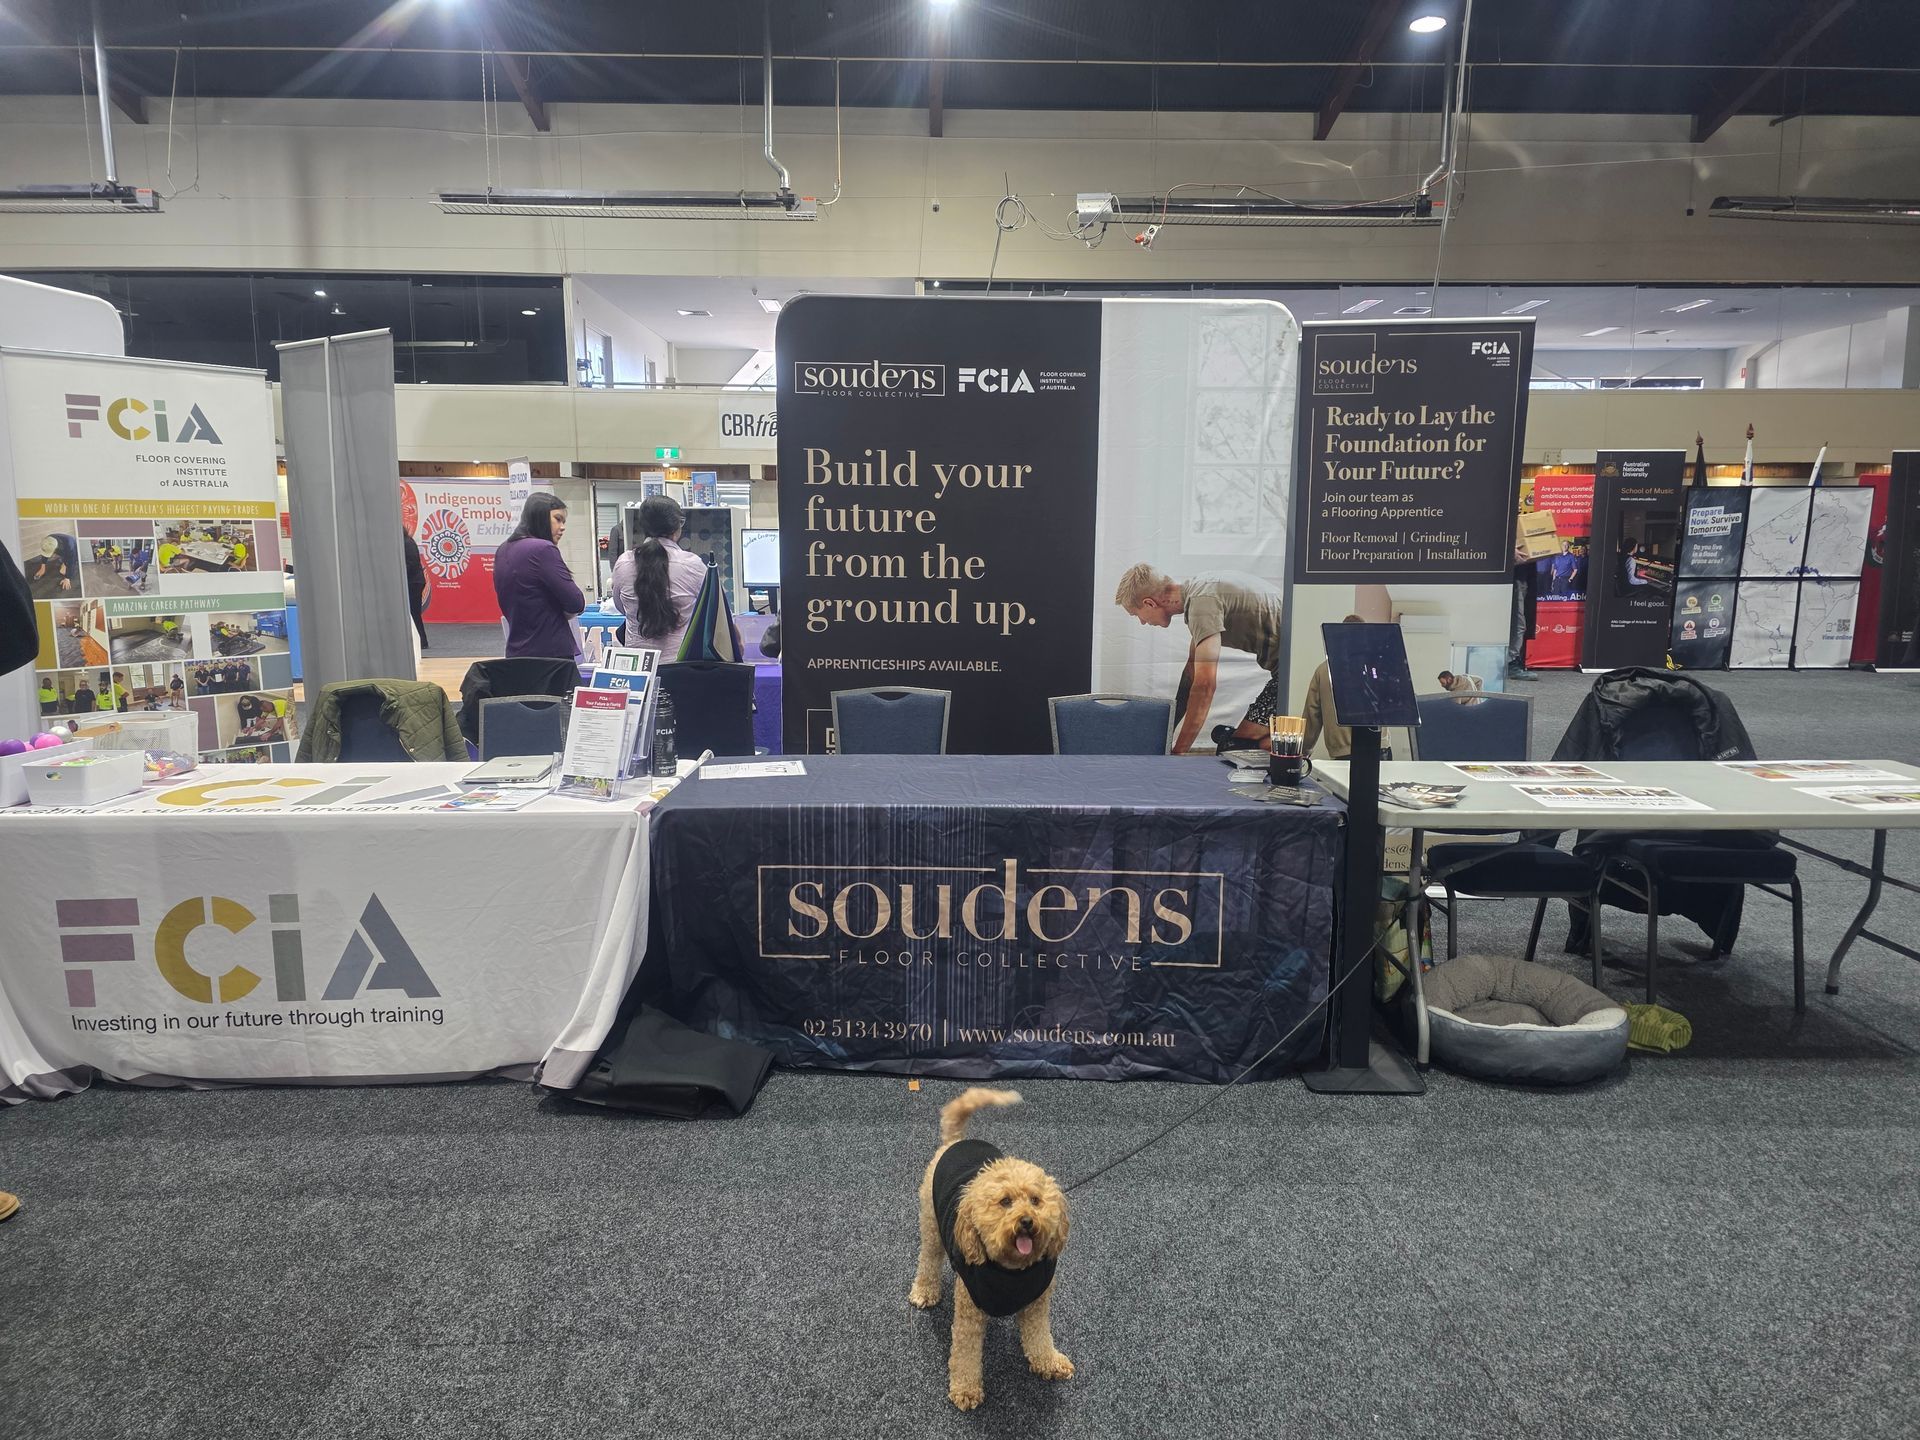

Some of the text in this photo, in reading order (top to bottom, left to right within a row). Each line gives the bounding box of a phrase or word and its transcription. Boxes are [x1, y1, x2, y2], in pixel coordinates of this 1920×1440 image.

[1319, 353, 1418, 375] soudens
[804, 360, 937, 390] soudens
[1327, 404, 1496, 432] Ready to Lay the
[1325, 431, 1487, 454] Foundation for
[136, 455, 226, 465] FLOOR COVERING
[176, 468, 227, 477] INSTITUTE
[804, 447, 1032, 499] Build your
[1323, 460, 1465, 481] Your Future?
[172, 480, 229, 488] AUSTRALIA
[424, 493, 502, 507] Indigenous
[1322, 492, 1414, 503] Join our team as
[44, 503, 259, 515] WORK IN ONE OF AUSTRALIA'S HIGHEST PAYING TRADES
[804, 496, 937, 535] future
[1322, 507, 1444, 519] a Flooring Apprentice
[1692, 508, 1723, 518] Prepare
[1691, 515, 1740, 526] Now. Survive
[1689, 525, 1729, 534] Tomorrow.
[1321, 531, 1460, 545] Floor Removal Grinding
[805, 541, 985, 581] from the
[1320, 548, 1487, 563] Floor Preparation Installation
[112, 598, 221, 612] AMAZING CAREER PATHWAYS
[1546, 594, 1570, 602] Willing.
[805, 589, 1036, 637] ground up.
[807, 658, 1002, 673] APPRENTICESHIPS AVAILABLE.
[290, 805, 400, 813] through
[787, 858, 1193, 946] soudens
[838, 949, 1142, 972] FLOOR COLLECTIVE
[72, 1004, 444, 1034] Investing in our future through training
[803, 1018, 1176, 1048] 02 5134 3970 www.soudens.com.au
